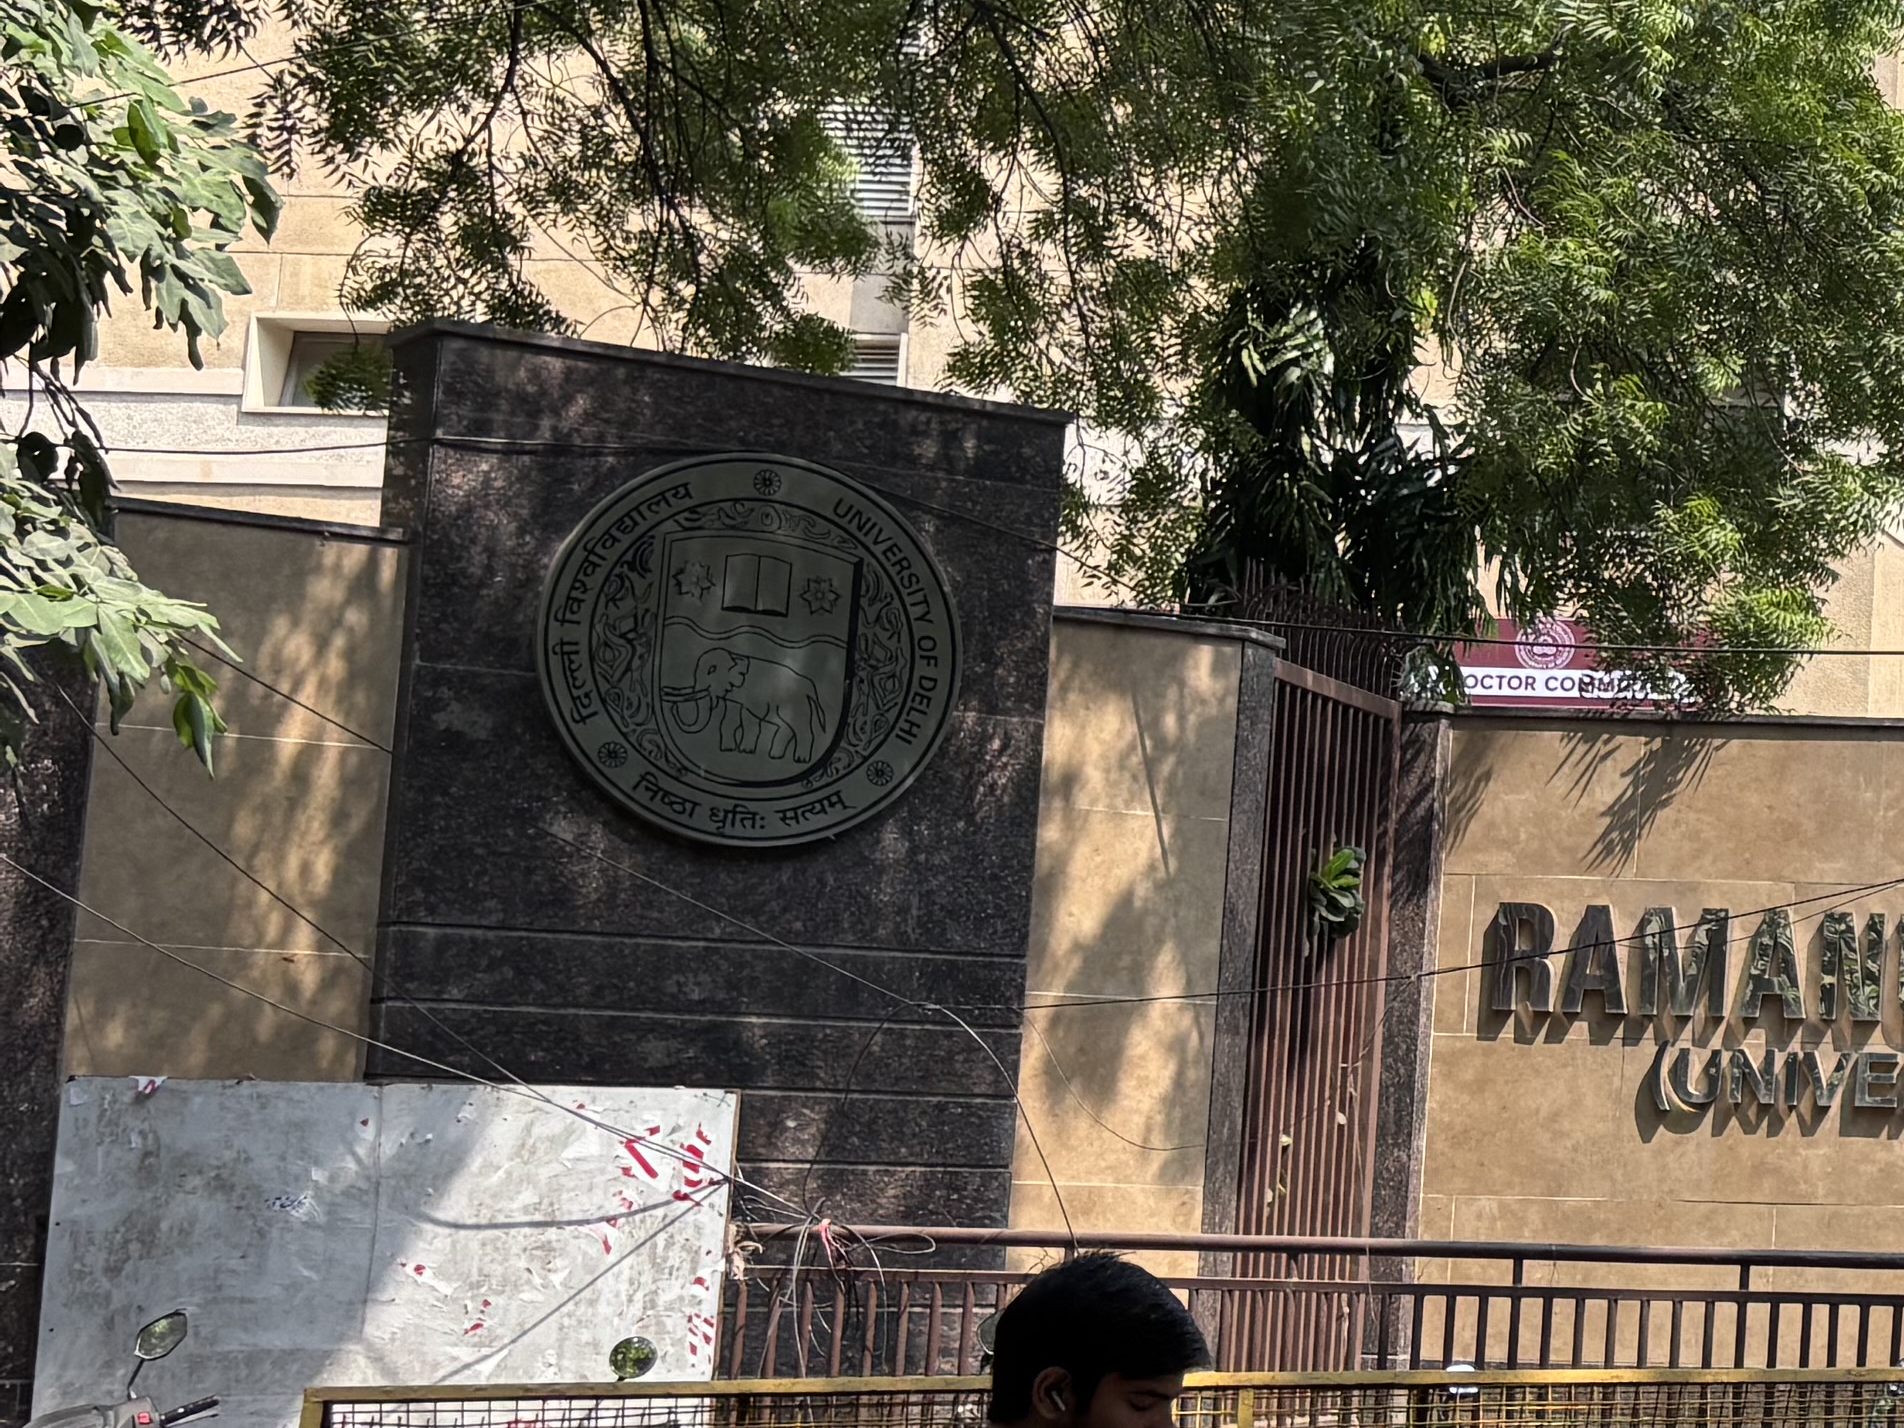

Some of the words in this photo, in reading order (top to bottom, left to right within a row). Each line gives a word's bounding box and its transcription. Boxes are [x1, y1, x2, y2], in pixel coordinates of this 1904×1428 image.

[554, 480, 695, 627] विश्वविद्यालय
[832, 497, 935, 626] UNIVERSITY
[552, 638, 599, 726] दिल्ली
[917, 635, 939, 669] OF
[1463, 674, 1537, 692] OCTOR
[895, 676, 939, 745] DELHI
[631, 770, 702, 819] निष्ठा
